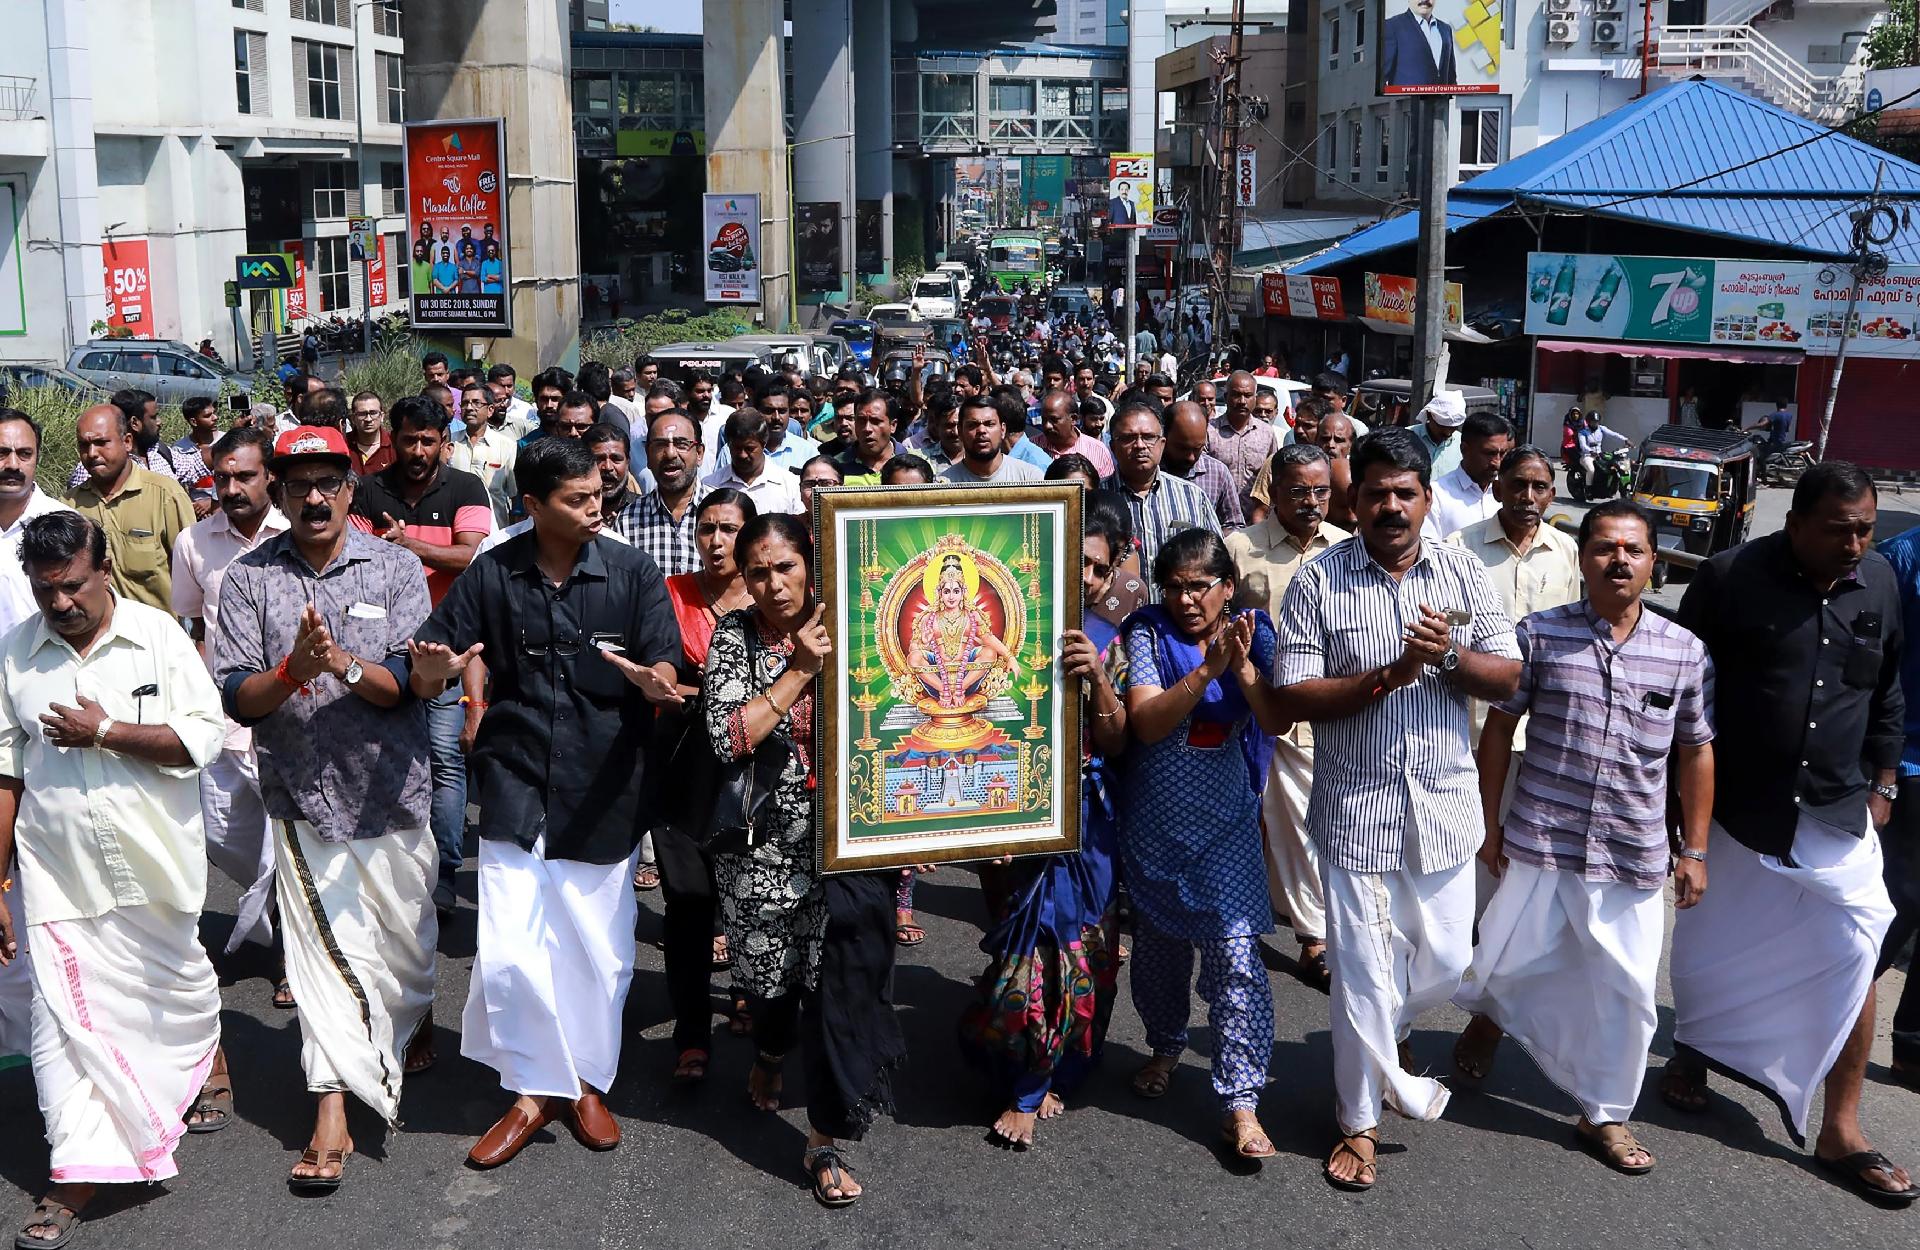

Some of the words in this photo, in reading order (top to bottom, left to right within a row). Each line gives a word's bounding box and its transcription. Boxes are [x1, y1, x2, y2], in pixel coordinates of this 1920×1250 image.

[425, 155, 446, 163] Centre
[446, 155, 467, 163] Square
[467, 153, 481, 161] Mall
[1041, 169, 1056, 177] OFF
[478, 173, 496, 188] FREE
[1241, 159, 1251, 202] ROOMS
[422, 196, 457, 214] Masala
[460, 193, 487, 215] Coffee
[113, 267, 147, 295] 50%
[1269, 277, 1284, 287] airtel
[1320, 281, 1337, 293] airtel
[1270, 289, 1283, 305] 4G
[1322, 294, 1336, 310] 4G
[1378, 289, 1406, 312] Juice
[1905, 291, 1914, 303] &
[420, 299, 429, 309] ON
[430, 299, 439, 309] 30
[439, 299, 452, 309] DEC
[453, 299, 472, 310] 2018,
[472, 299, 497, 309] SUNDAY
[124, 313, 140, 322] TASTY
[421, 310, 428, 318] AT
[428, 310, 447, 318] CENTRE
[447, 310, 467, 318] SQUARE
[467, 310, 483, 318] MALL,
[483, 310, 488, 318] 6
[488, 310, 497, 318] PM
[679, 360, 721, 368] POLICE
